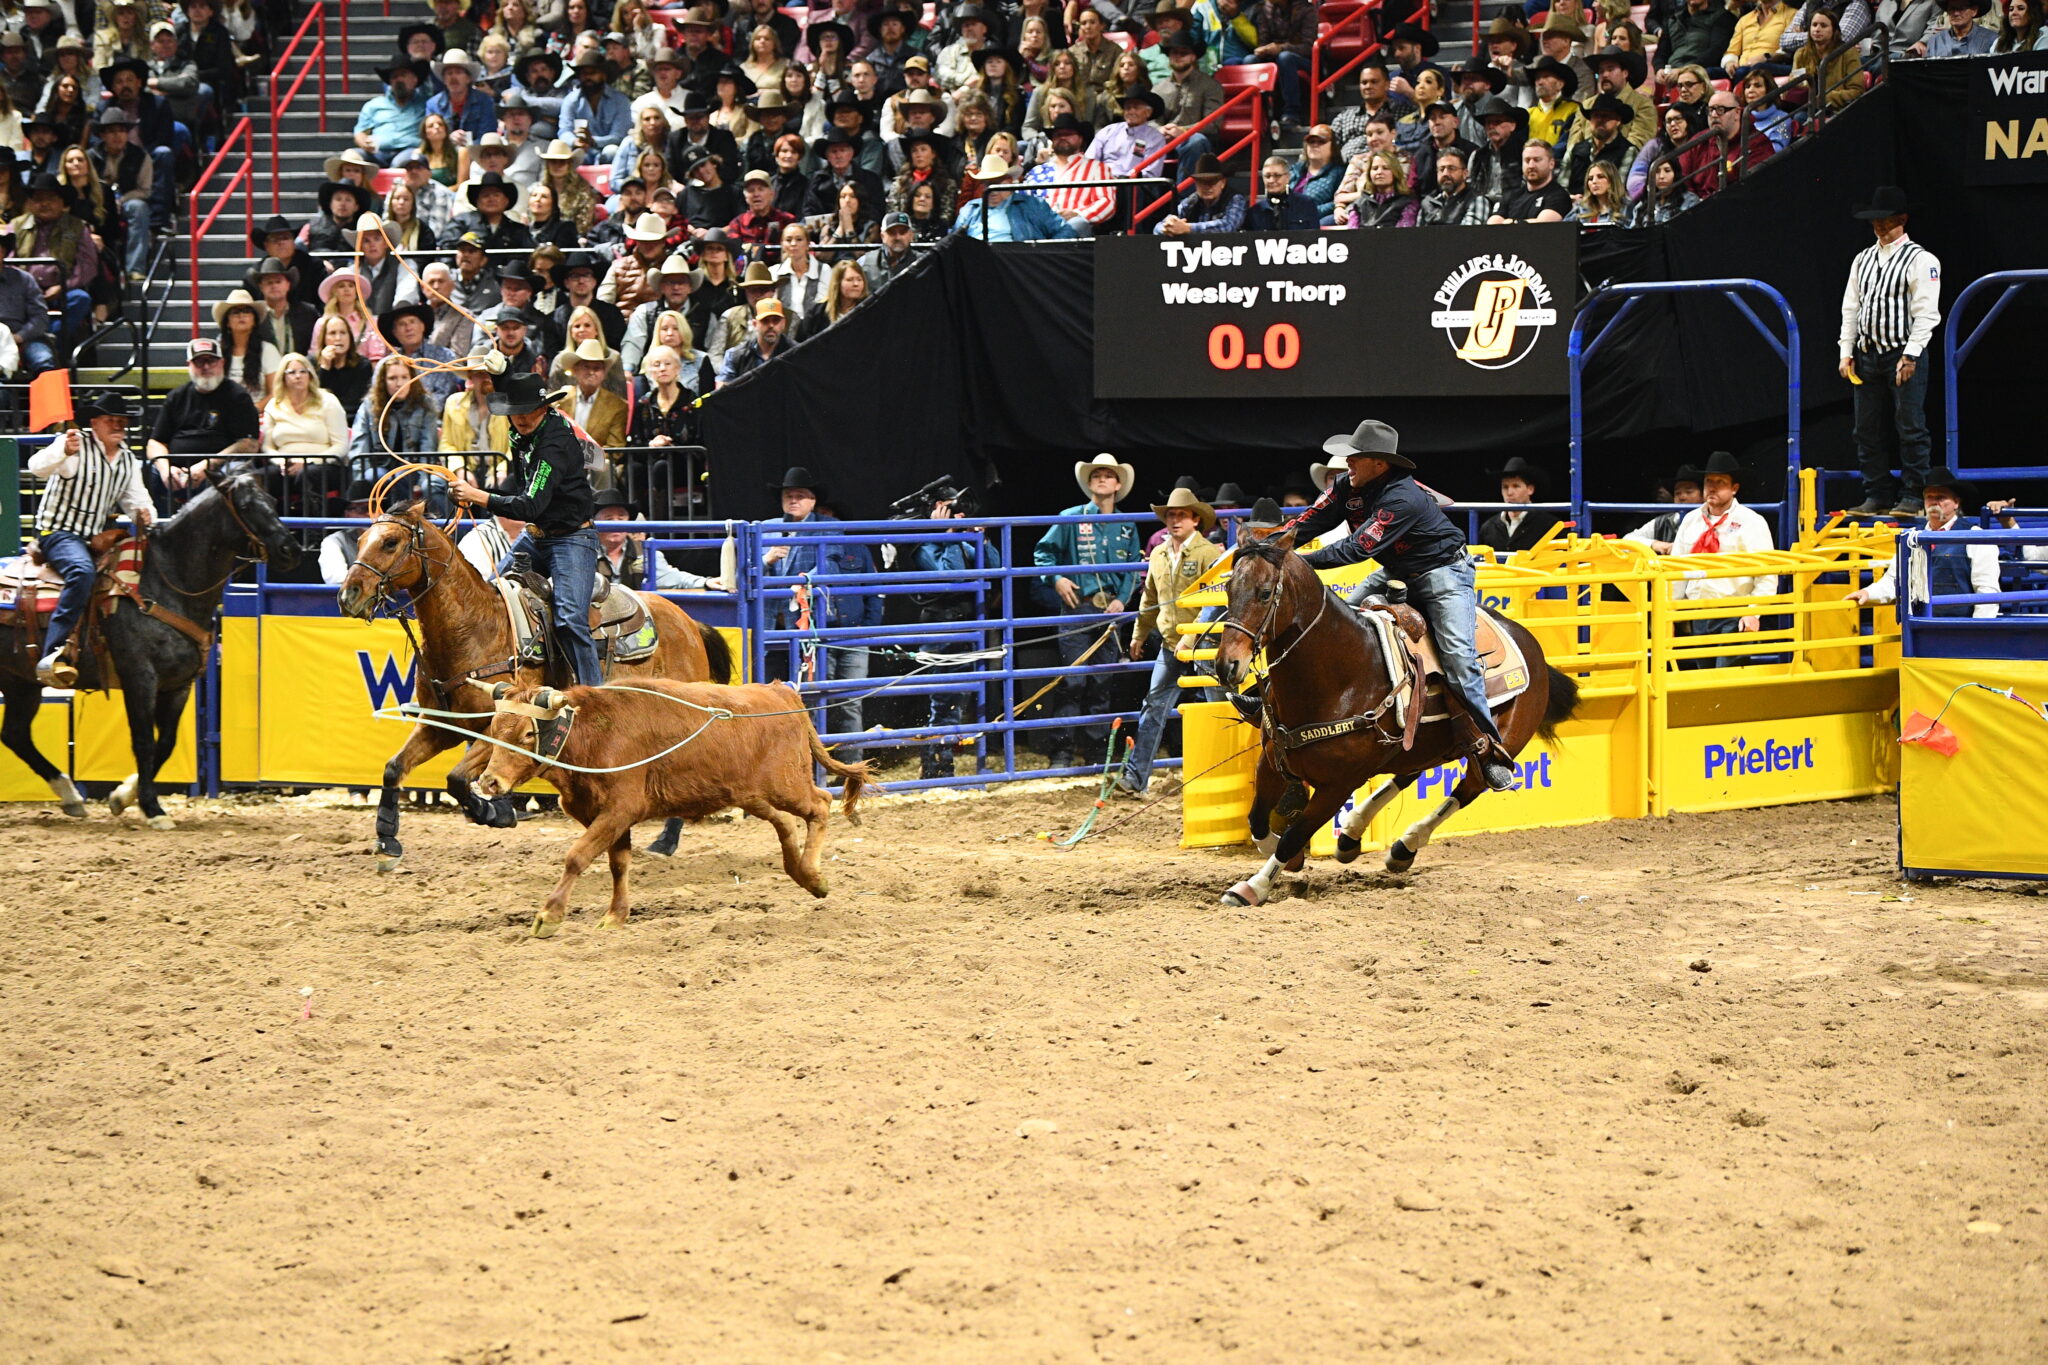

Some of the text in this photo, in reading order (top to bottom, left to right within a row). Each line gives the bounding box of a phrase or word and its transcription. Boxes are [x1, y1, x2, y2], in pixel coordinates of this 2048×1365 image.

[1985, 118, 2048, 160] NA
[1160, 237, 1349, 273] Tyler Wade
[1161, 280, 1346, 308] Wesley Thorp
[1434, 253, 1553, 306] PHILLIPS & JORDAN
[1208, 323, 1300, 370] 0.0
[1300, 720, 1355, 741] SADDLERY
[1704, 736, 1813, 779] Priefert
